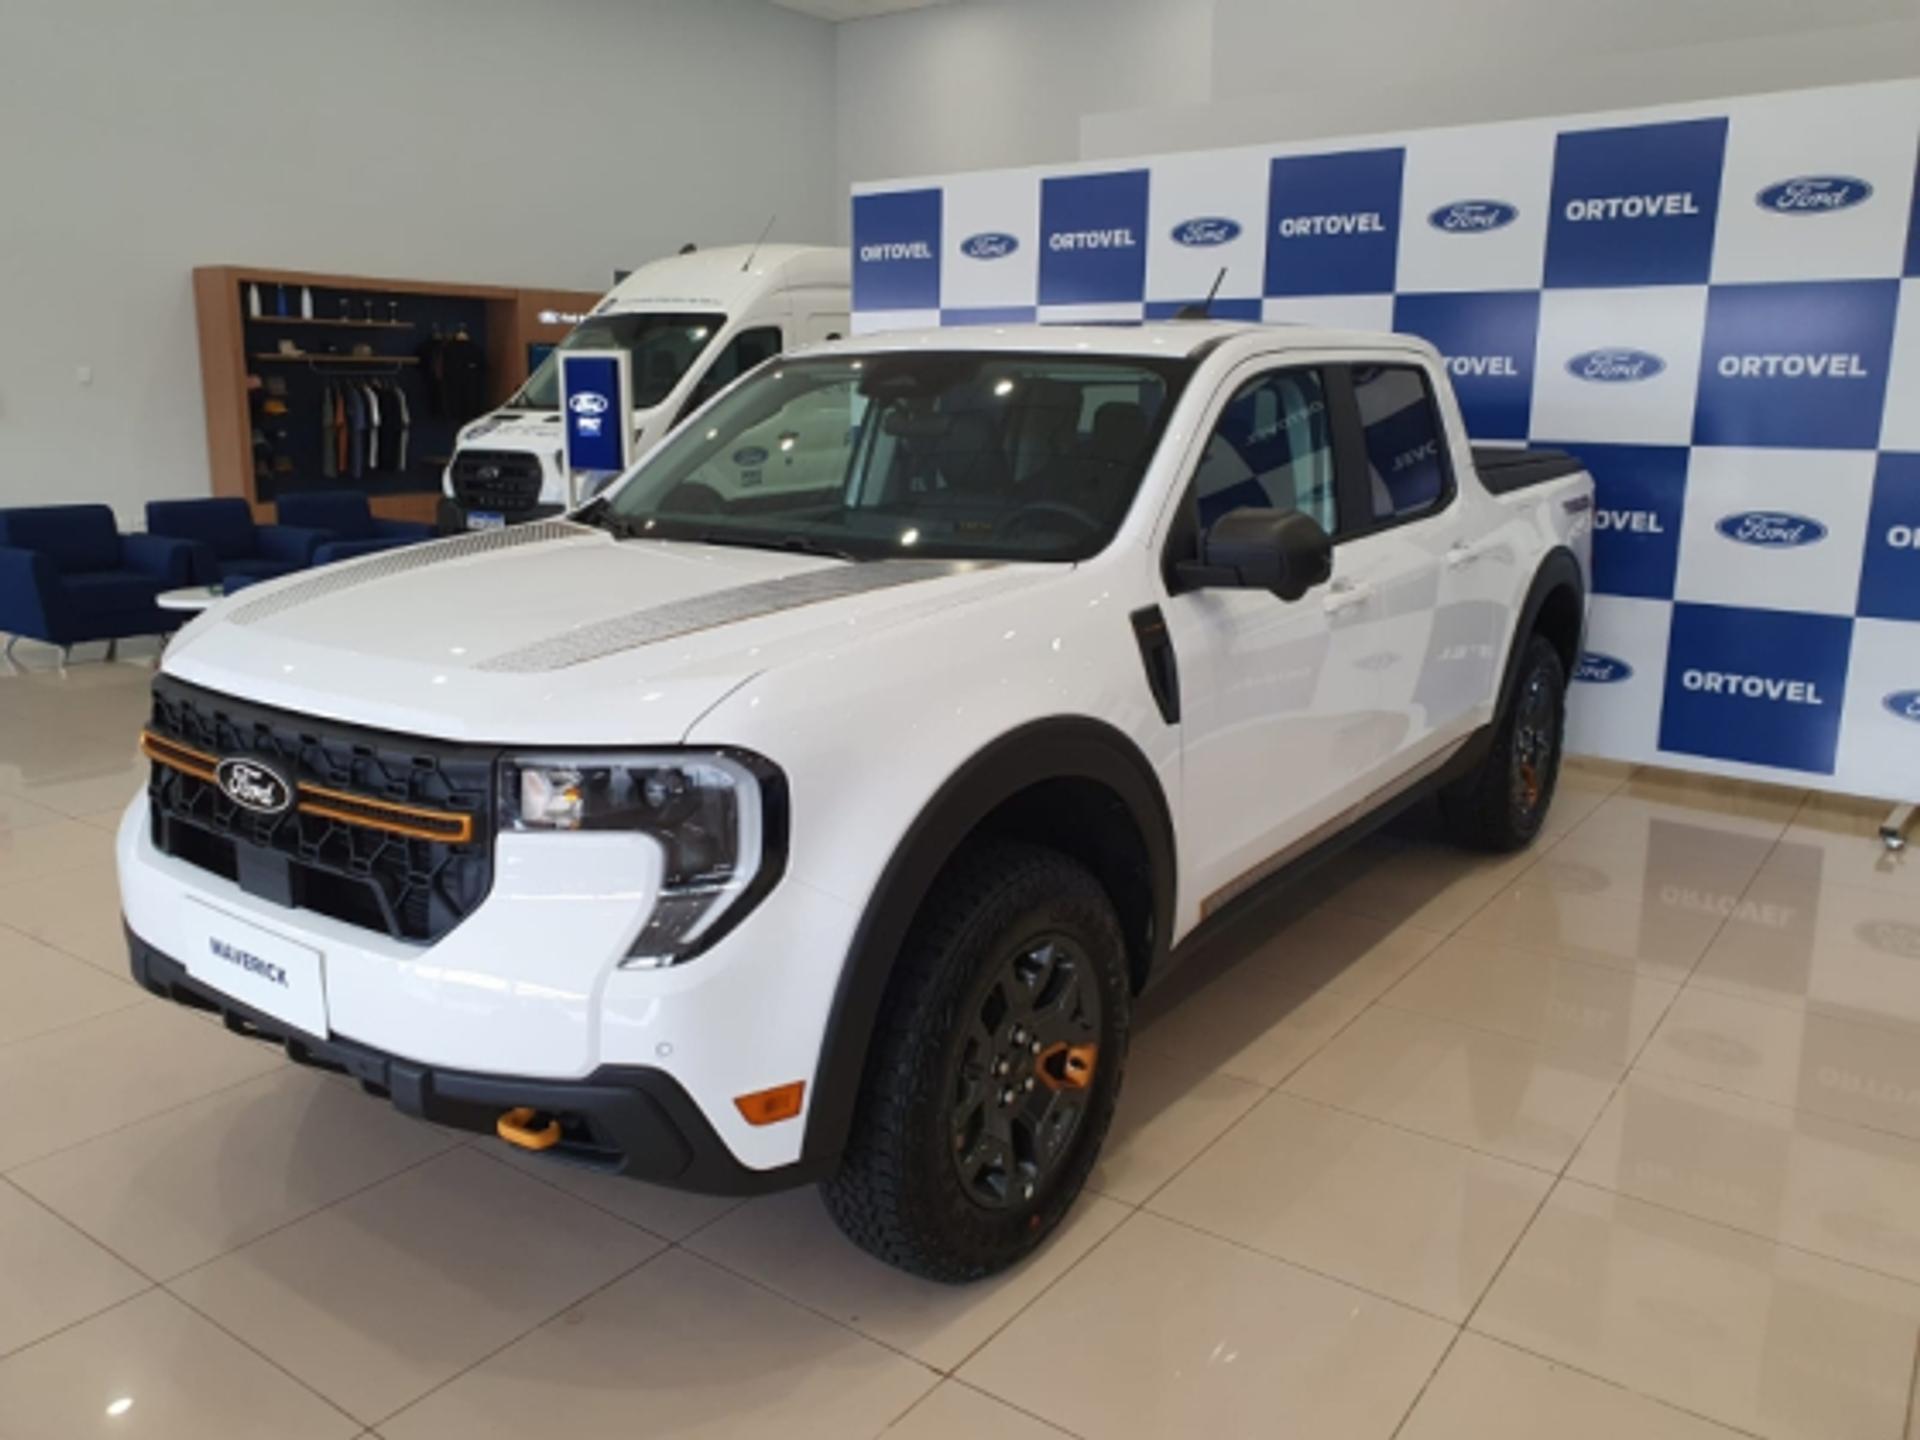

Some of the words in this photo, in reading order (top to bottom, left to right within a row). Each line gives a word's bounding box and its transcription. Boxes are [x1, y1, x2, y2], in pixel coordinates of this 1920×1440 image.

[1777, 181, 1849, 208] Ford
[1444, 205, 1500, 228] Ford
[1566, 193, 1699, 221] ORTOVEL
[1280, 212, 1385, 238] ORTOVEL
[861, 243, 932, 261] ORTOVEL
[1050, 229, 1136, 251] ORTOVEL
[1584, 356, 1643, 376] Ford
[1719, 355, 1866, 377] ORTOVEL
[1595, 510, 1664, 533] OVEL
[1738, 516, 1804, 541] Ford
[1683, 670, 1823, 705] ORTOVEL
[209, 936, 288, 988] MAVERICK
